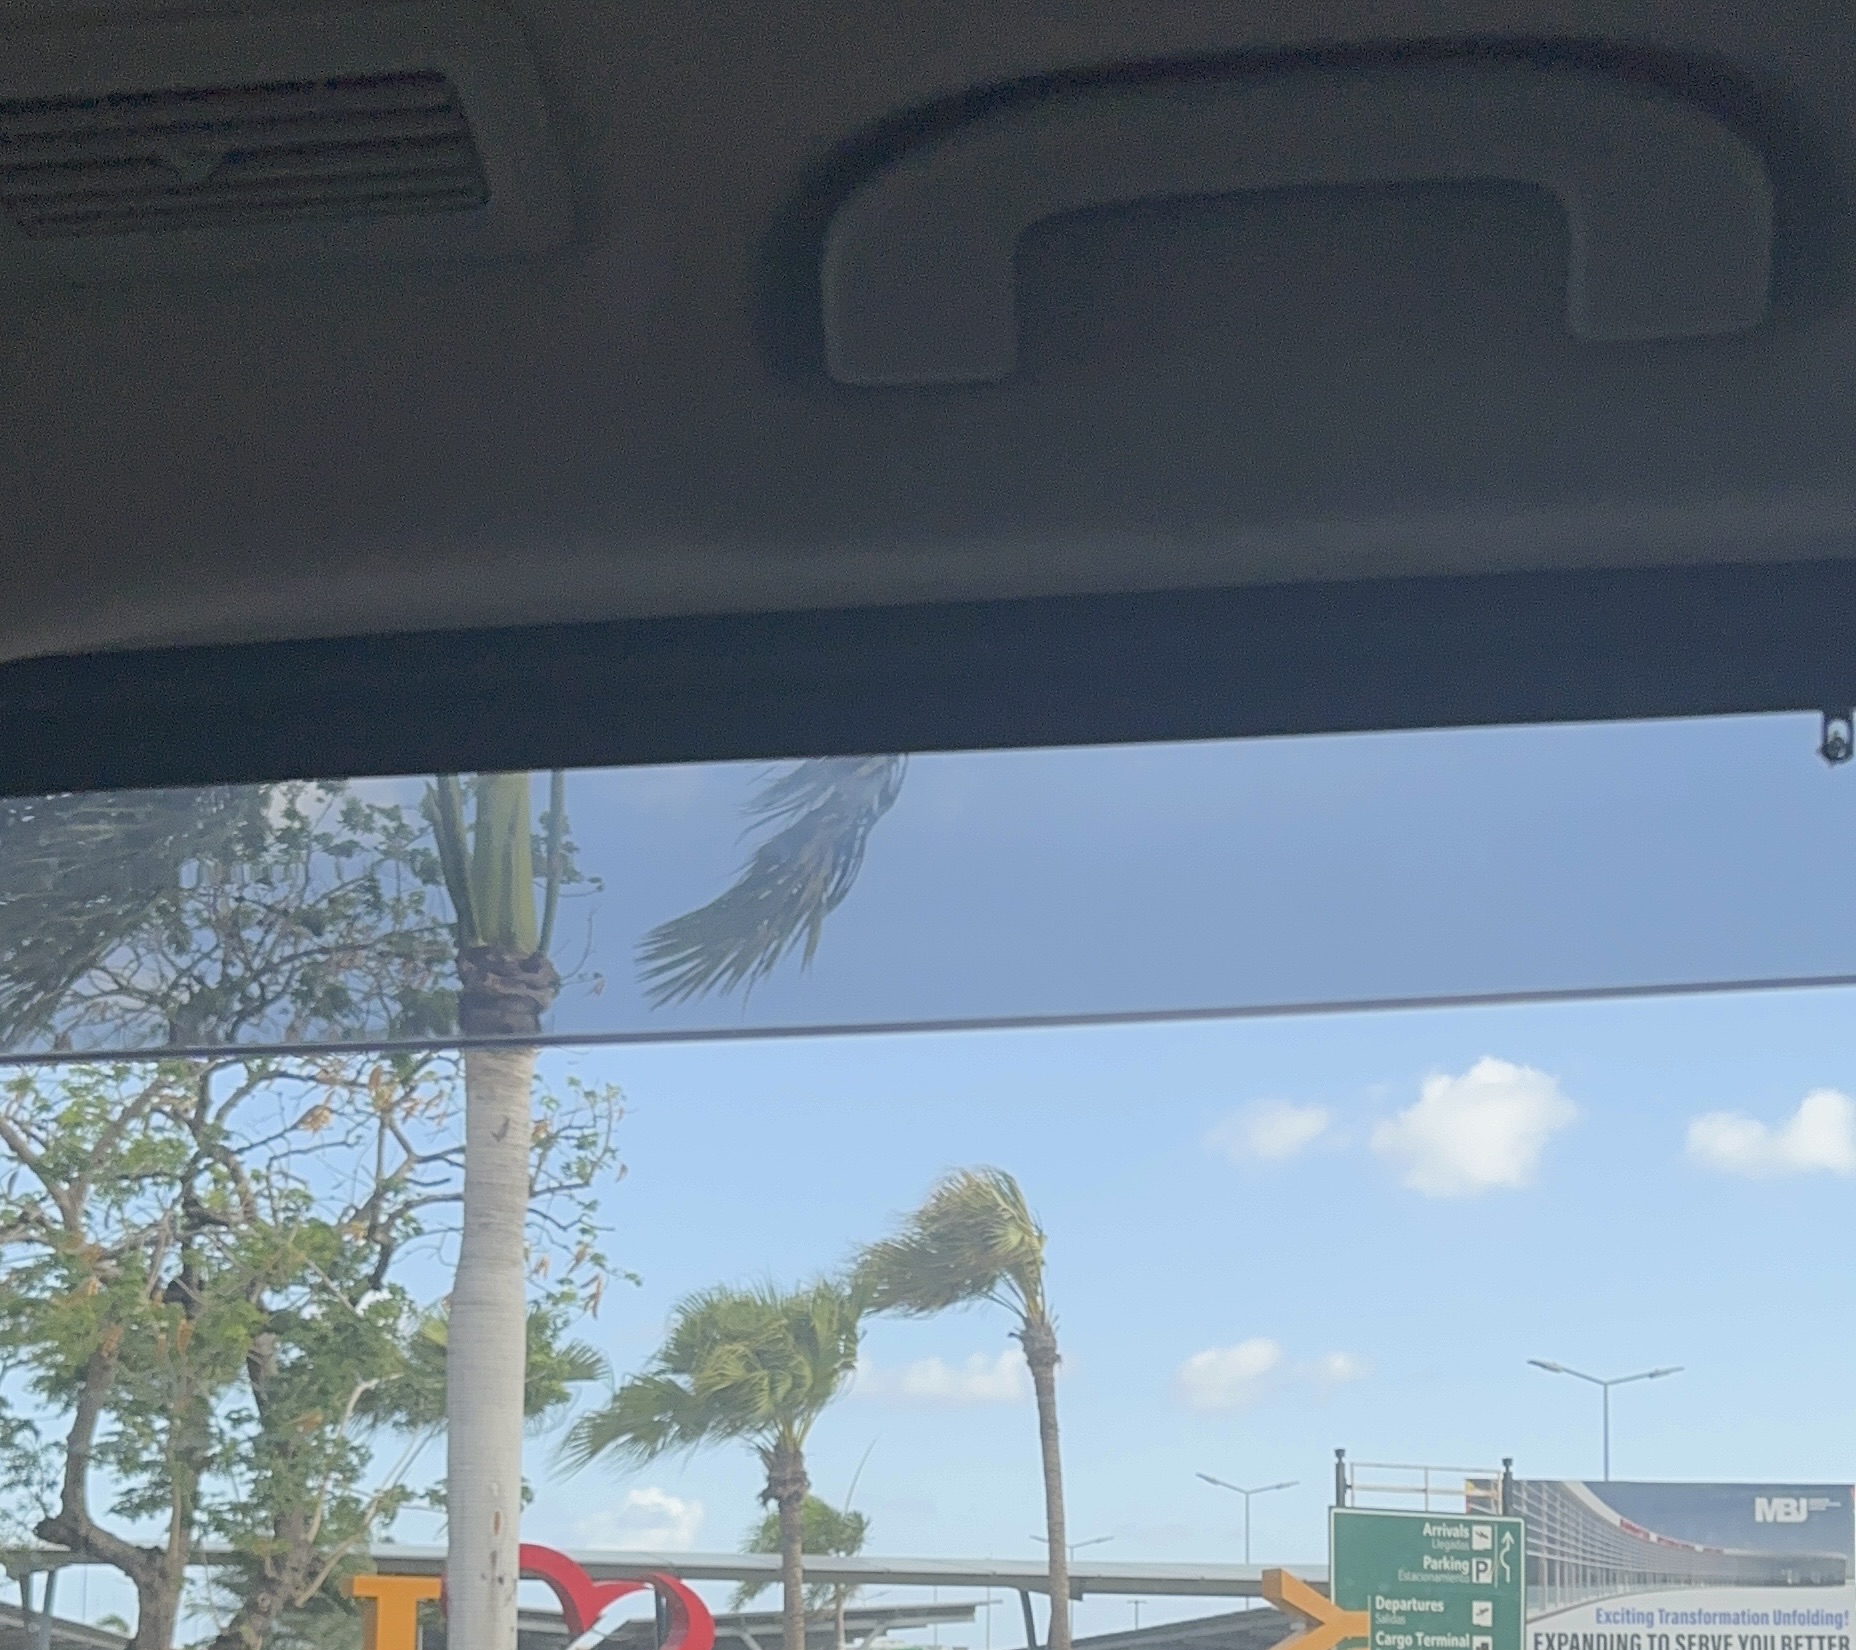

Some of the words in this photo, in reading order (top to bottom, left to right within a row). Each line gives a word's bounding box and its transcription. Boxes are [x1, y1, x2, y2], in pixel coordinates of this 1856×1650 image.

[1754, 1496, 1808, 1522] MBJ
[1422, 1522, 1470, 1538] Arrivals
[1431, 1540, 1470, 1552] Llegadas
[1422, 1555, 1470, 1575] Parking
[1475, 1560, 1489, 1581] P
[1375, 1595, 1444, 1615] Departures
[1375, 1612, 1406, 1625] Salidas
[1595, 1608, 1655, 1629] Exciting
[1657, 1608, 1770, 1626] Transformation
[1772, 1609, 1850, 1631] Unfolding!
[1375, 1630, 1413, 1649] Cargo
[1415, 1631, 1470, 1648] Terminal
